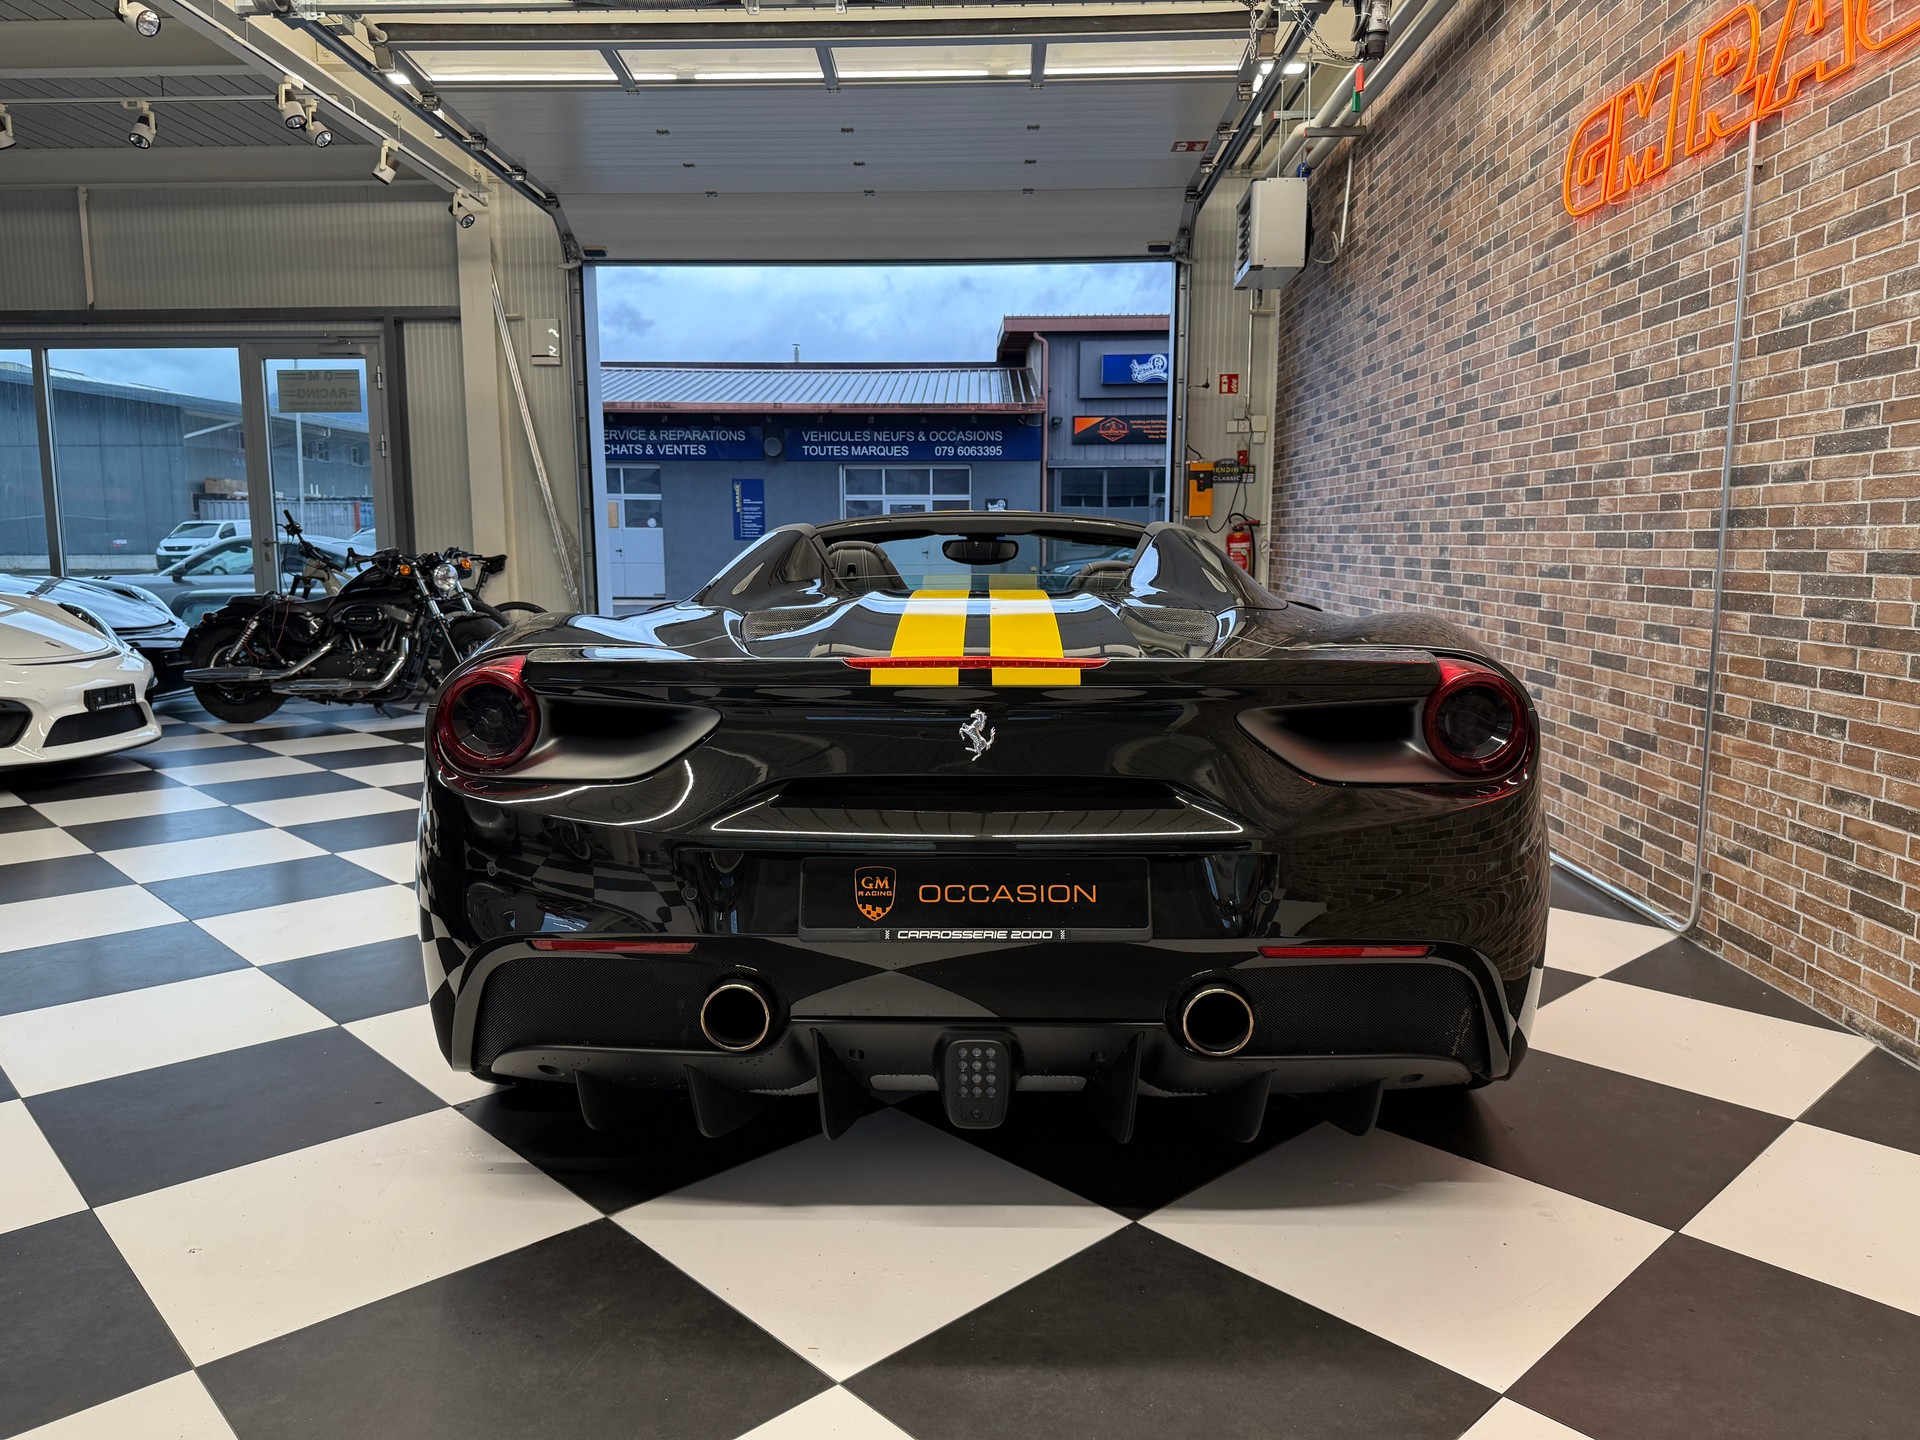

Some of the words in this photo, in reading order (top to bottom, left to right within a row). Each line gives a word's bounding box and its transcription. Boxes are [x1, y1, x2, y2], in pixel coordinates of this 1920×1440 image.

[649, 430, 658, 441] &
[660, 430, 746, 441] REPARATIONS
[802, 431, 871, 442] VEHICULES
[874, 431, 915, 442] NEUFS
[918, 431, 926, 442] &
[929, 431, 1003, 442] OCCASIONS
[604, 444, 643, 455] CHATS
[646, 444, 654, 455] &
[657, 444, 707, 455] VENTES
[802, 445, 849, 456] TOUTES
[851, 445, 909, 456] MARQUES
[934, 445, 955, 456] 079
[957, 445, 1003, 456] 6063395
[861, 876, 890, 890] GM
[918, 884, 1097, 903] OCCASION
[897, 930, 1008, 939] CARROSSERIE
[1010, 930, 1053, 939] 2000
